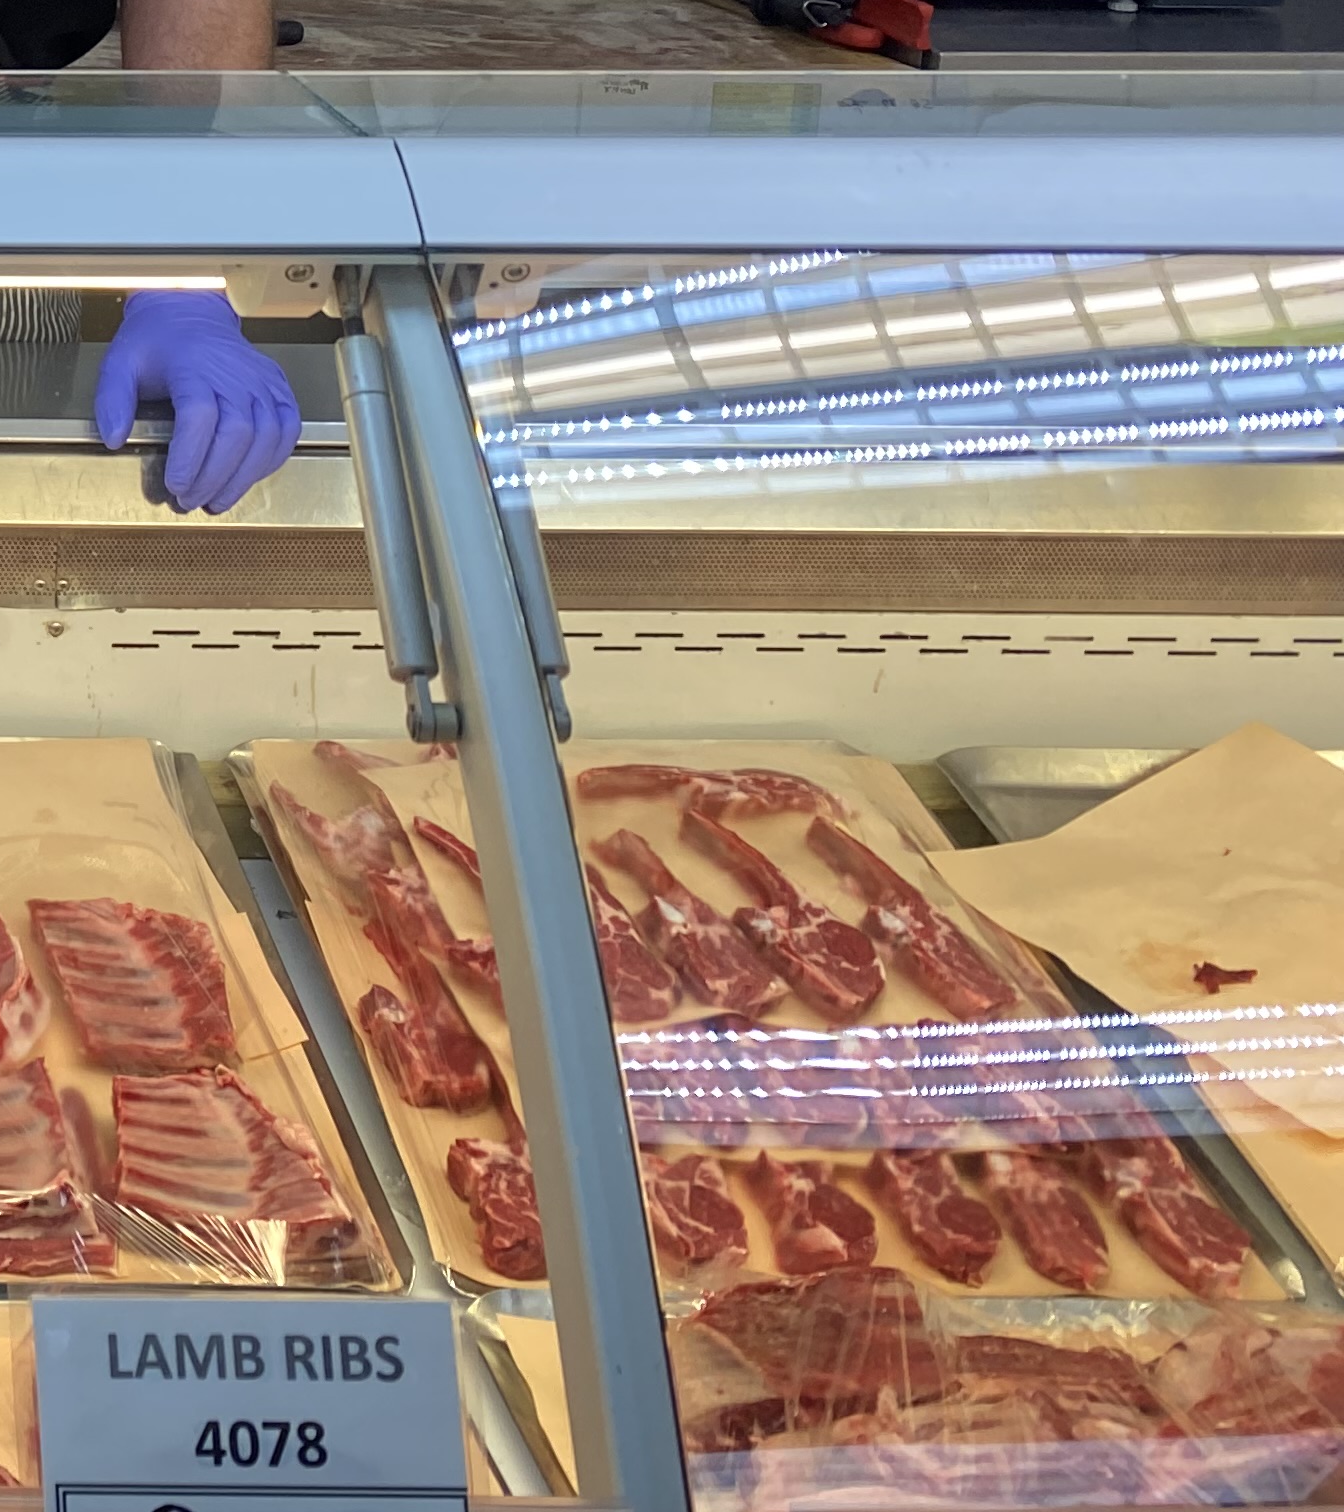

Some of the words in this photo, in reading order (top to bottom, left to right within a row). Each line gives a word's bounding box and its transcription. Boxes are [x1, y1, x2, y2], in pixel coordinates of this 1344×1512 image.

[107, 1333, 265, 1381] LAMB
[284, 1334, 405, 1383] RIBS
[195, 1420, 328, 1469] 4078
